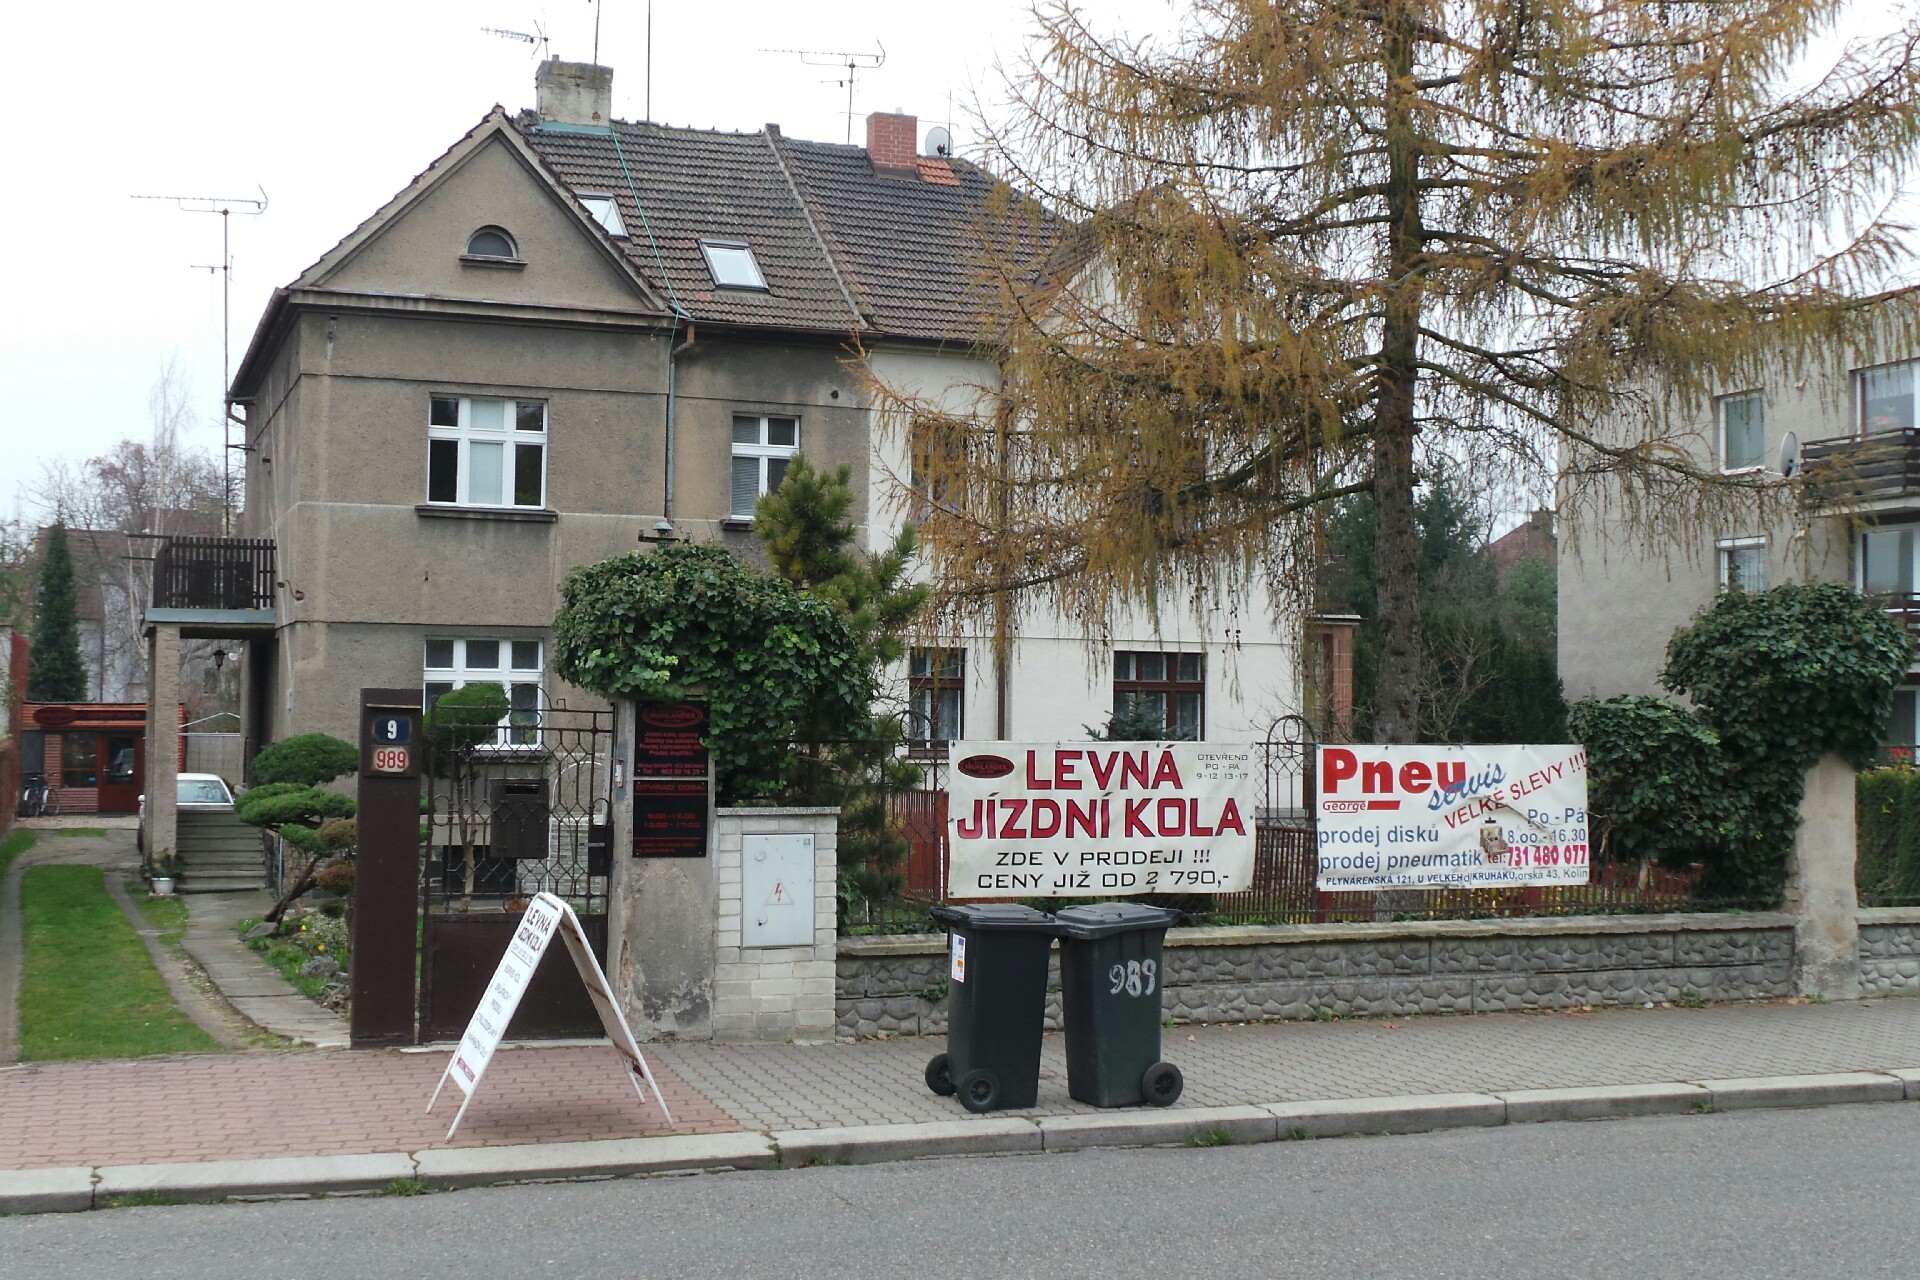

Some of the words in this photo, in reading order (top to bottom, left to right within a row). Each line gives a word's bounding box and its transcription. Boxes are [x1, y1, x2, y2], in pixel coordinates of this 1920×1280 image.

[387, 720, 397, 739] 9
[376, 750, 407, 769] 989
[1197, 752, 1248, 761] OTEVŘENO
[1026, 744, 1184, 790] LEVNÁ
[1322, 748, 1466, 794] Pneu
[1427, 762, 1507, 811] servis
[1444, 787, 1510, 829] VELKÉ
[1510, 761, 1563, 801] SLEVY
[957, 791, 1114, 840] JÍZDNÍ
[1124, 798, 1247, 838] KOLA
[1322, 800, 1366, 813] George
[1527, 809, 1550, 824] Po
[1564, 807, 1585, 823] Pá
[1319, 826, 1380, 848] prodej
[1387, 823, 1439, 843] disků
[1551, 828, 1586, 843] 16.30
[995, 852, 1043, 866] ZDE
[1053, 852, 1070, 866] V
[1080, 850, 1183, 866] PRODEJI
[1193, 850, 1211, 864] !!!
[1320, 851, 1381, 873] prodej
[1387, 849, 1482, 871] pneumatik
[1507, 846, 1529, 867] 731
[1533, 845, 1559, 866] 480
[1563, 844, 1587, 865] 077
[977, 873, 1044, 889] CENY
[1053, 870, 1091, 888] JIŽ
[1102, 872, 1136, 888] OD
[1145, 871, 1159, 885] 2
[1170, 870, 1229, 888] 790,-
[1326, 874, 1393, 886] PLYNÁRENSKÁ
[1397, 875, 1414, 885] 121,
[1418, 875, 1424, 883] U
[1109, 959, 1157, 997] 989
